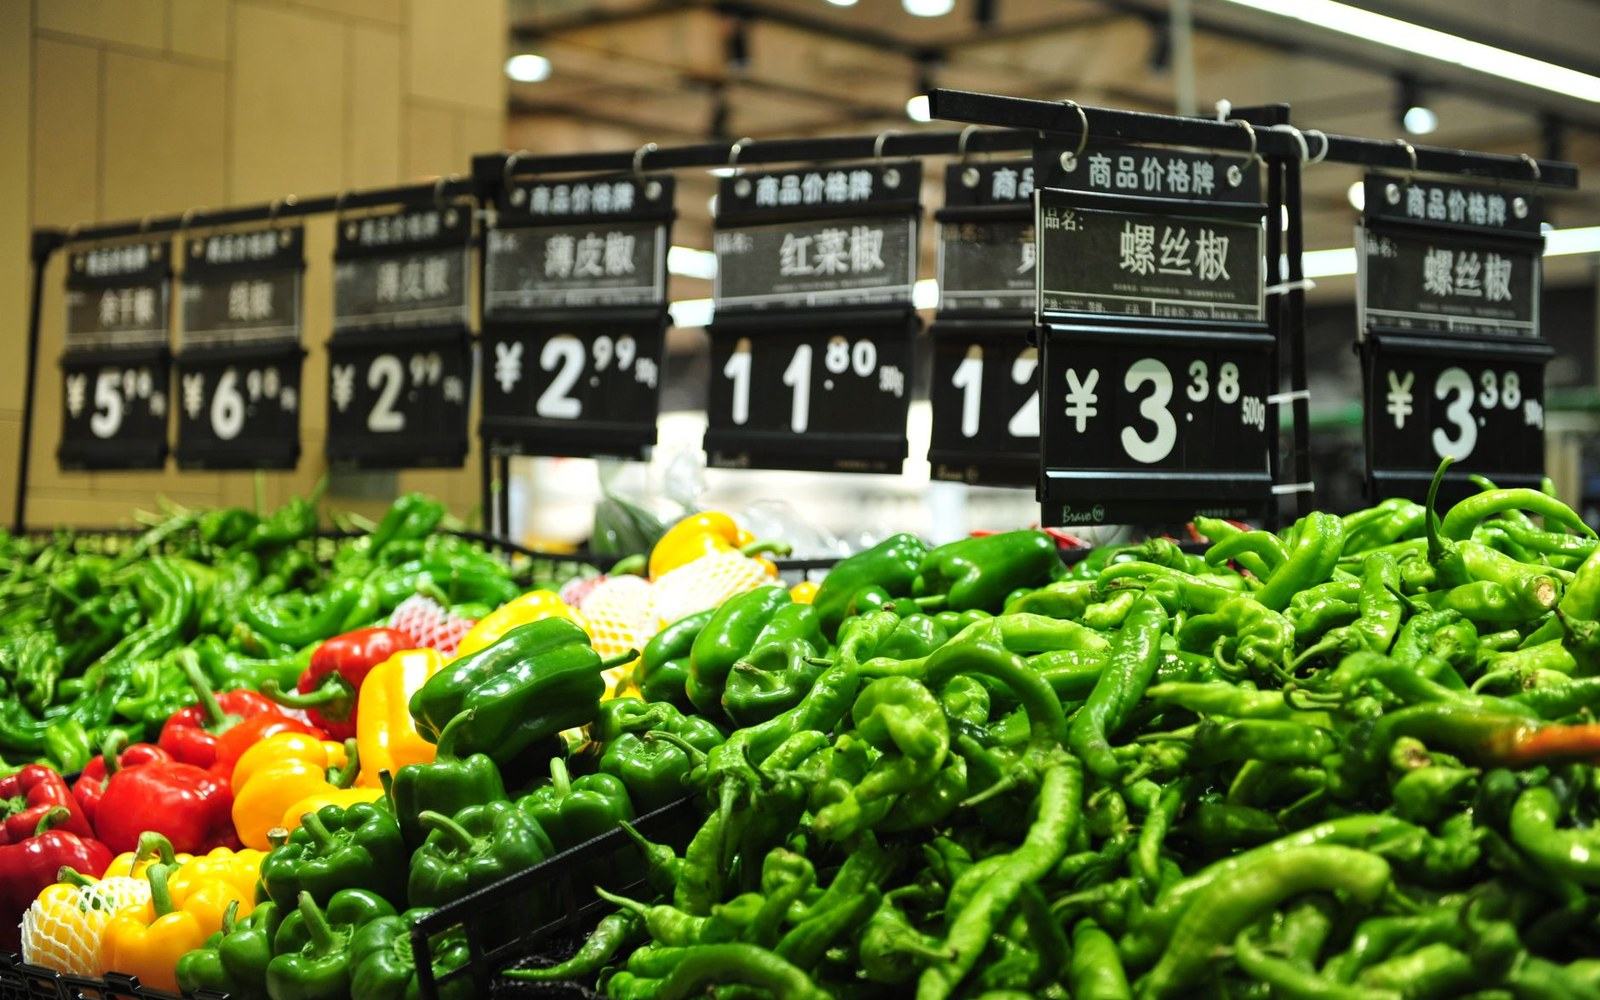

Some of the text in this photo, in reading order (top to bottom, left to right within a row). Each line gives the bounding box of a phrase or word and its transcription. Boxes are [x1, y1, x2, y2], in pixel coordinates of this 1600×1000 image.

[756, 169, 874, 206] 商品价格牌
[1088, 152, 1215, 194] 商品价格牌
[530, 181, 635, 215] 商品价格牌
[1406, 184, 1507, 228] 商品价格牌
[544, 231, 636, 278] 薄皮椒
[778, 226, 884, 277] 红菜椒
[1119, 220, 1231, 283] 螺丝椒
[1423, 246, 1513, 302] 螺丝椒
[1242, 396, 1266, 432] 500g
